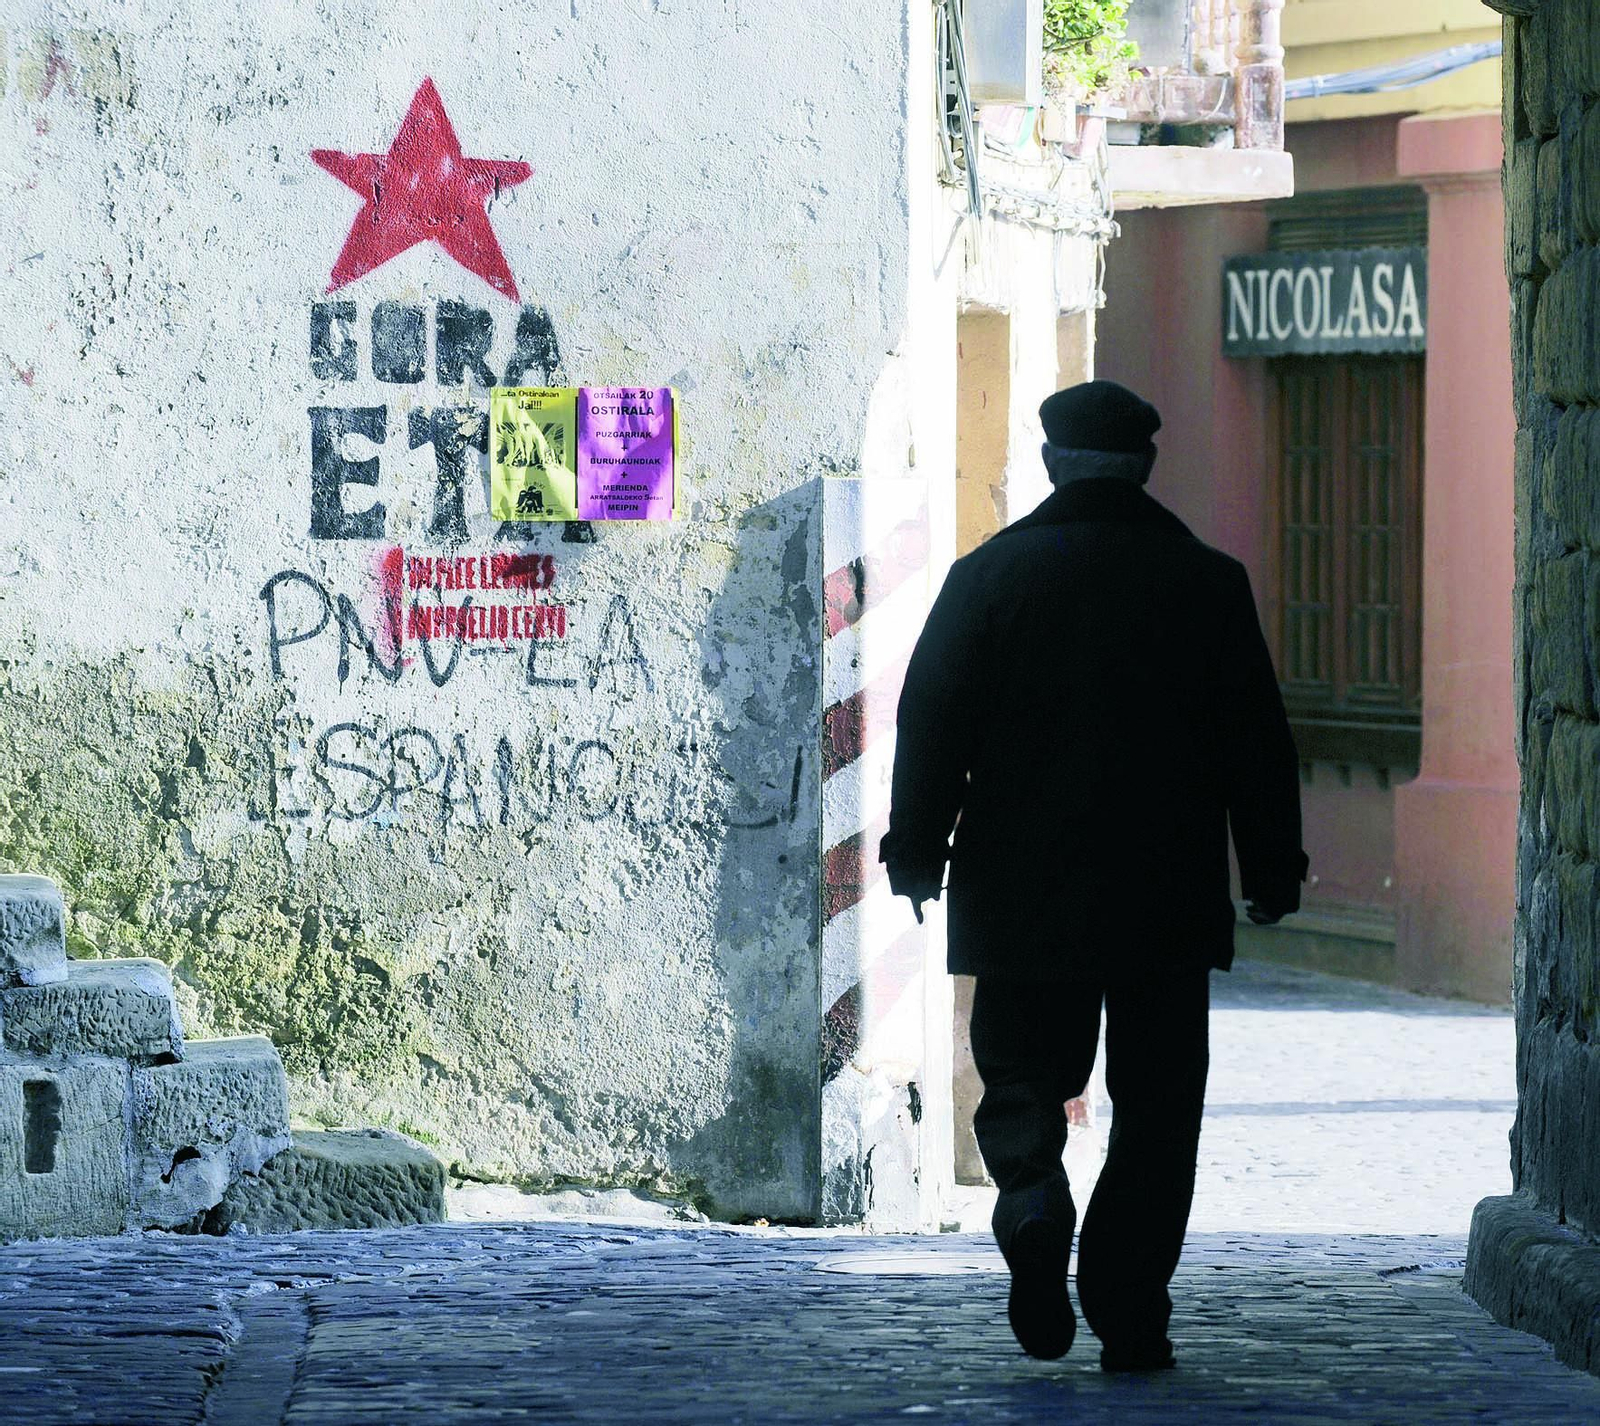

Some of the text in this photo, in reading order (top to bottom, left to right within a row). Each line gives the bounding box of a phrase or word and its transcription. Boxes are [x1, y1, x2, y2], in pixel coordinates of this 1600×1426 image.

[1226, 262, 1424, 341] NICOLASA
[309, 299, 561, 388] GORA
[518, 390, 560, 398] Ostiralean
[639, 390, 654, 399] 20
[518, 400, 542, 410] Jai!!!
[591, 406, 655, 415] OSTIRALA
[590, 457, 661, 465] BURUHAUNDIAK
[307, 404, 598, 544] ET
[602, 484, 649, 492] MERIENDA
